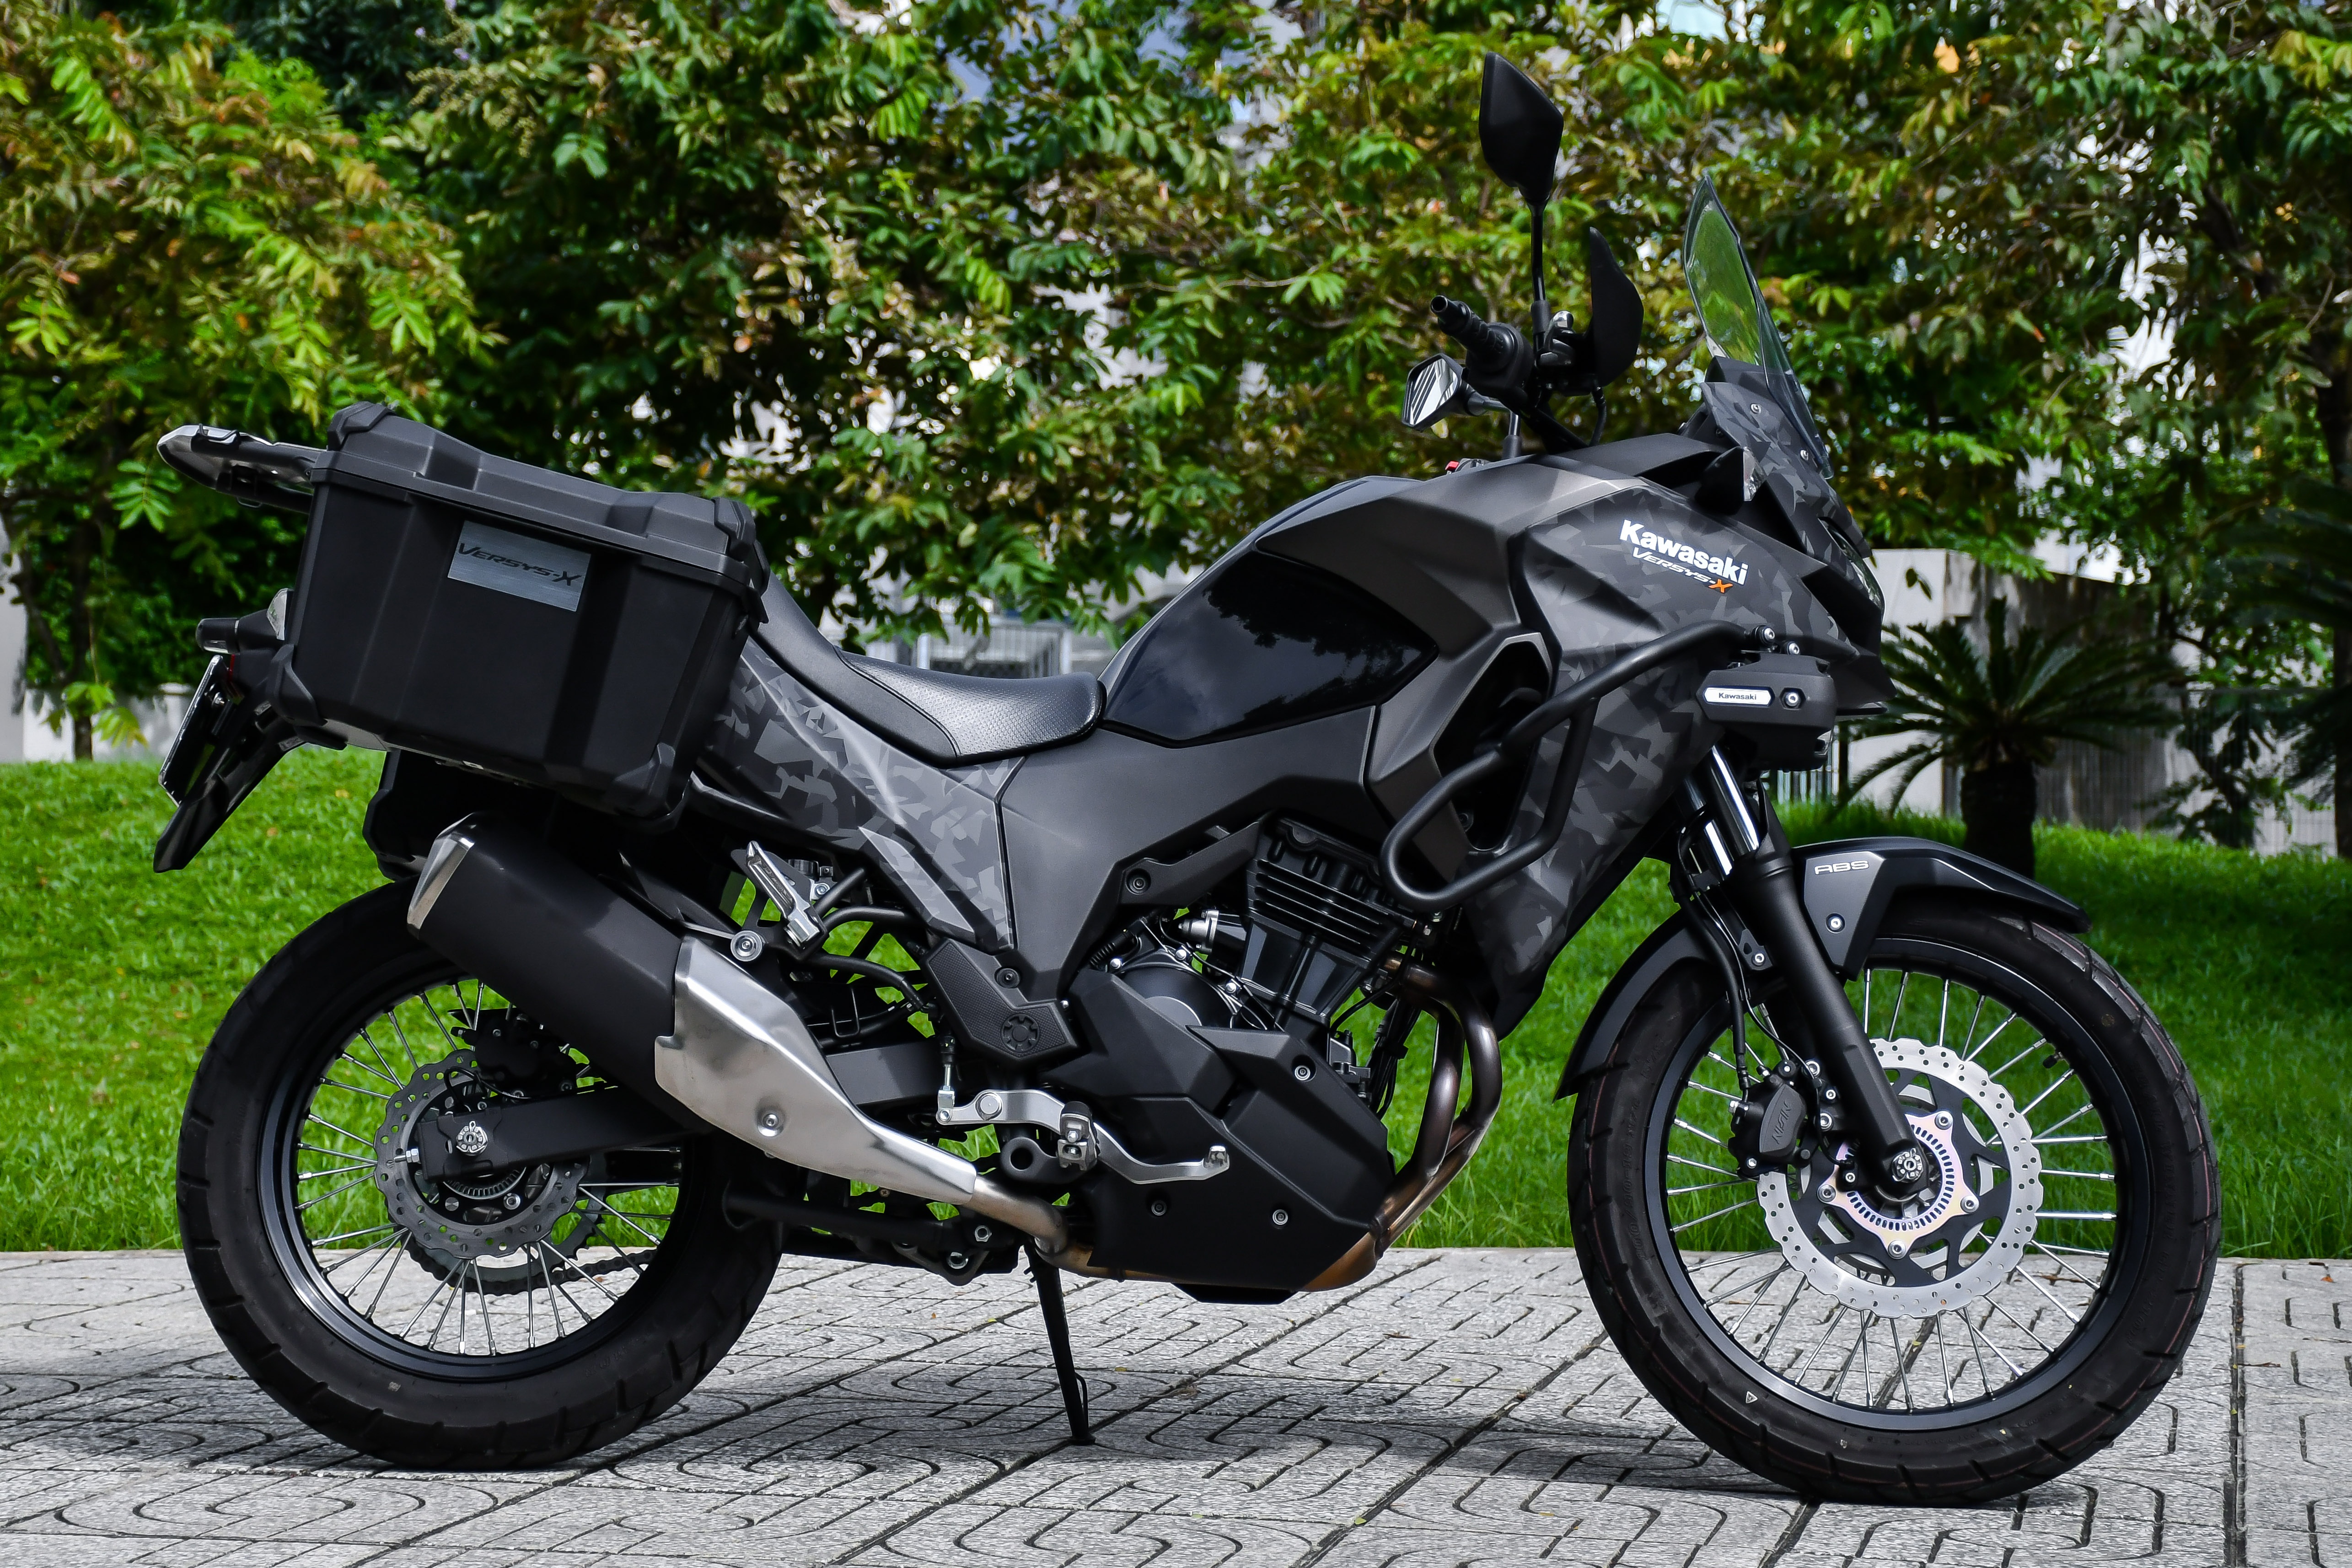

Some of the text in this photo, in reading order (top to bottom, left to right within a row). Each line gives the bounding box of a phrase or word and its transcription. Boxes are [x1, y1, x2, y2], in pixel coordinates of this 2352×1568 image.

[458, 542, 581, 586] VERSYS-X
[1619, 519, 1750, 586] Kawasaki
[1632, 547, 1733, 594] VERSYS-X
[1718, 692, 1757, 701] Kawasaki
[1814, 860, 1869, 875] ABS
